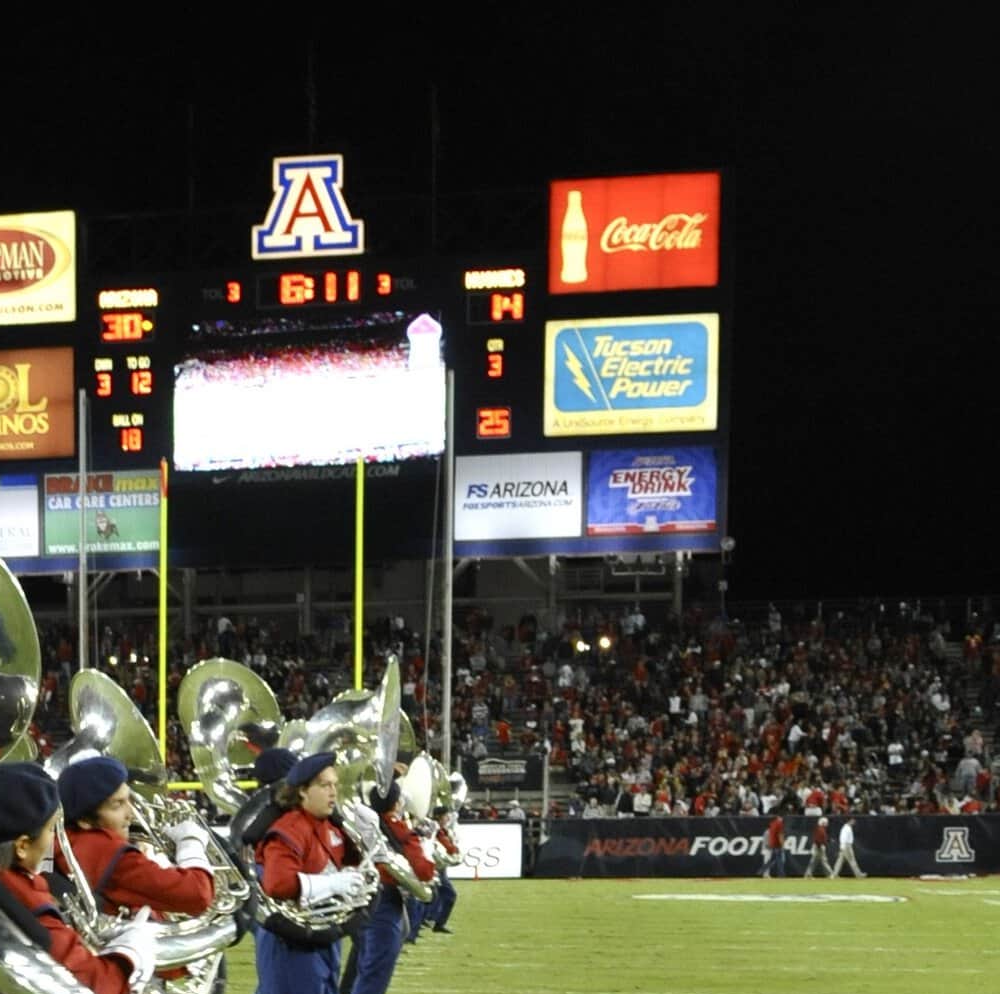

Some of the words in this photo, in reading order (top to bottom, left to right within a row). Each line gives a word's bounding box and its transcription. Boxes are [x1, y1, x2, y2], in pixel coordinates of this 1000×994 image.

[252, 154, 365, 260] A
[601, 213, 708, 253] Coca-Cola
[227, 282, 241, 302] 3
[377, 274, 391, 295] 3
[491, 293, 523, 321] 14
[102, 313, 143, 340] 30
[593, 335, 673, 358] Tucson
[487, 353, 502, 377] 3
[601, 355, 694, 377] Electric
[97, 373, 112, 396] 3
[131, 371, 152, 395] 12
[609, 377, 693, 399] Power
[479, 409, 510, 436] 25
[48, 496, 72, 509] CAR
[75, 494, 105, 508] CARE
[109, 492, 160, 507] CENTERS
[466, 484, 489, 498] FS
[489, 480, 569, 498] ARIZONA
[48, 541, 160, 554] www.rakemax.com
[583, 836, 690, 857] ARIZONA
[688, 836, 816, 856] FOOTAL
[936, 827, 975, 862] A
